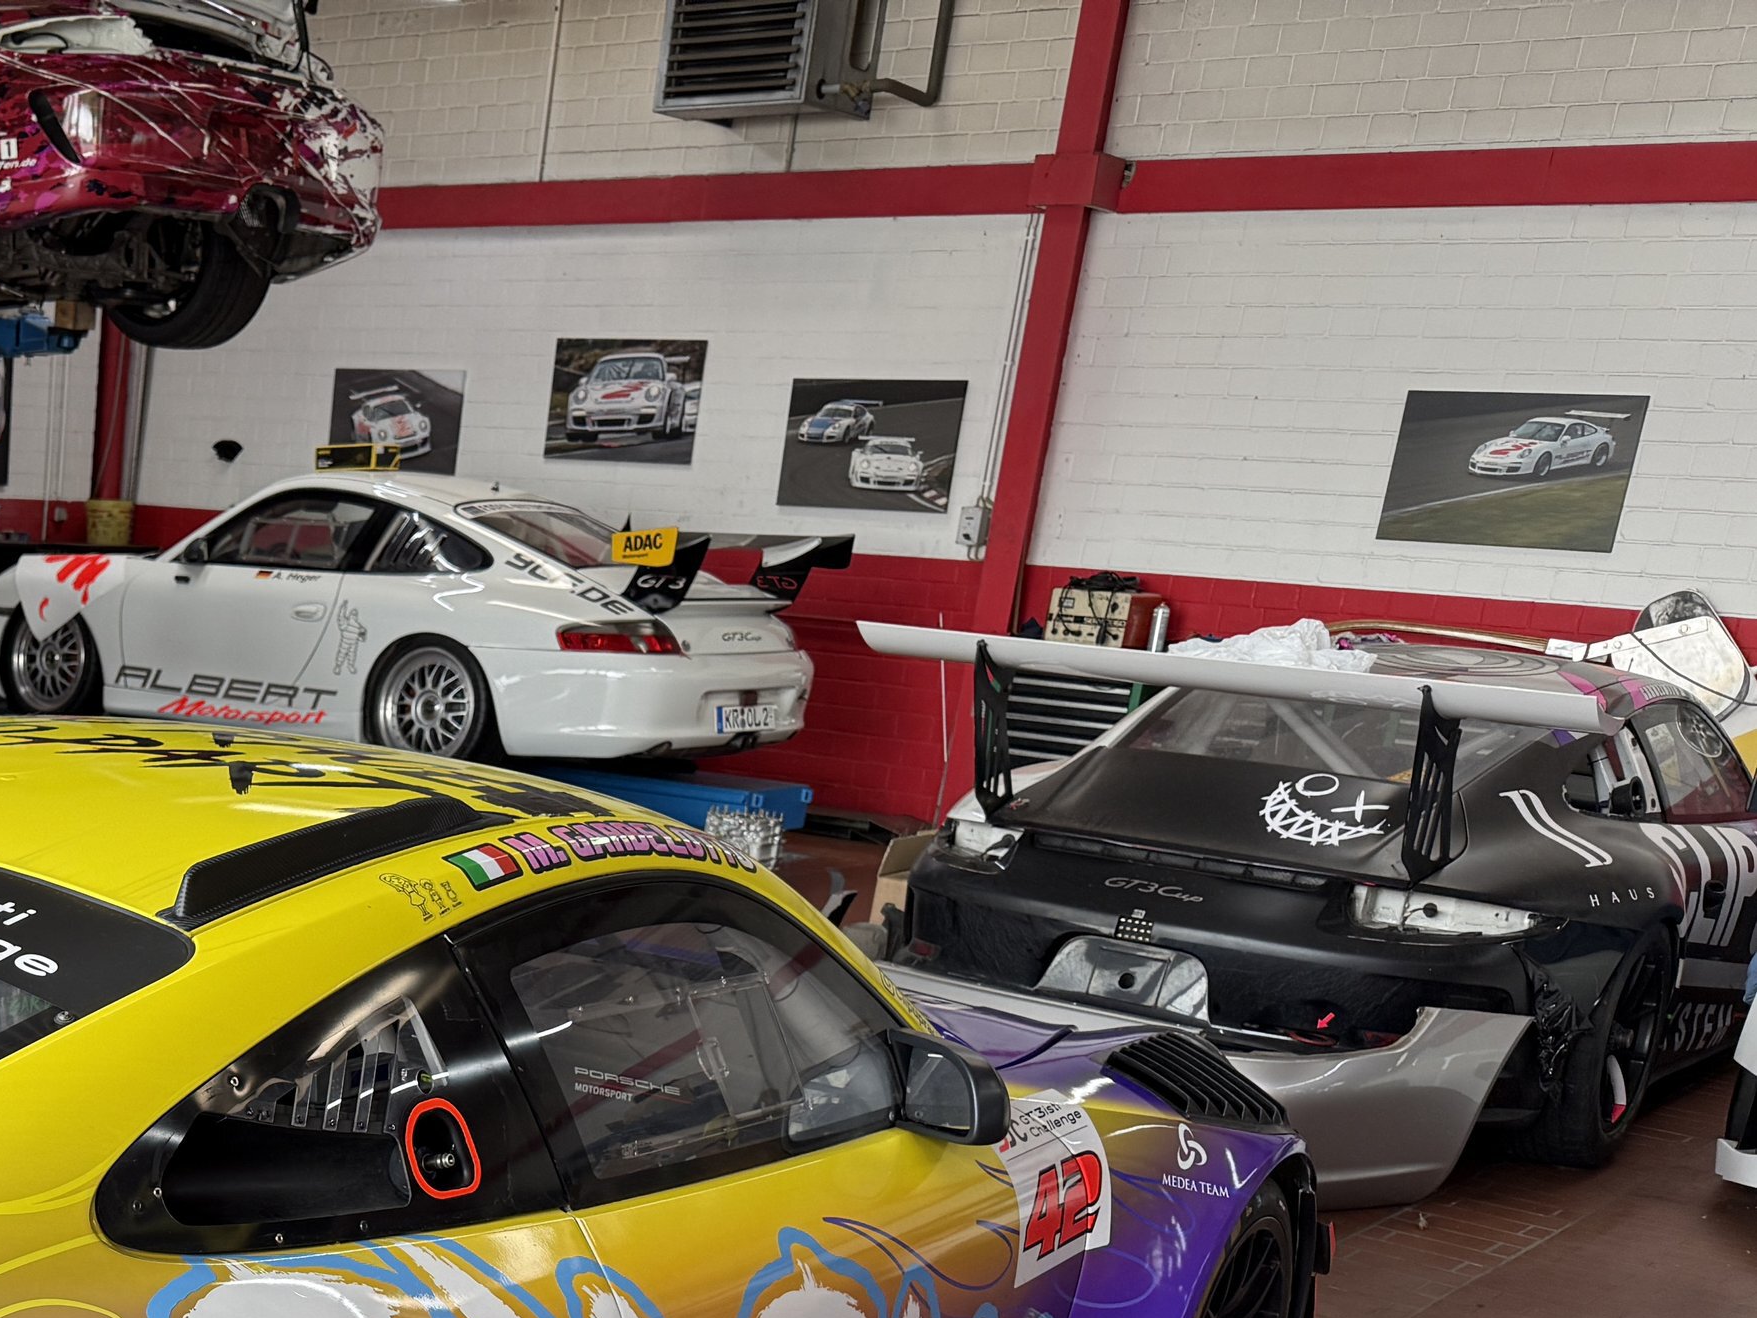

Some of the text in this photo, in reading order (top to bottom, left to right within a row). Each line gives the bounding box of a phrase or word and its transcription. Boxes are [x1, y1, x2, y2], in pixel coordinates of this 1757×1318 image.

[623, 533, 663, 552] ADAC
[636, 574, 687, 590] GT3
[114, 664, 338, 711] ALBERT
[157, 695, 328, 726] Motorsport
[724, 708, 740, 729] KR
[502, 831, 570, 873] M.
[1589, 886, 1655, 907] HAUS
[574, 1067, 681, 1096] PORSCHE
[574, 1082, 633, 1102] MOTORSPORT
[1029, 1110, 1082, 1137] Challenge
[1162, 1173, 1230, 1198] MEDEA TEAM
[1023, 1150, 1102, 1261] 42
